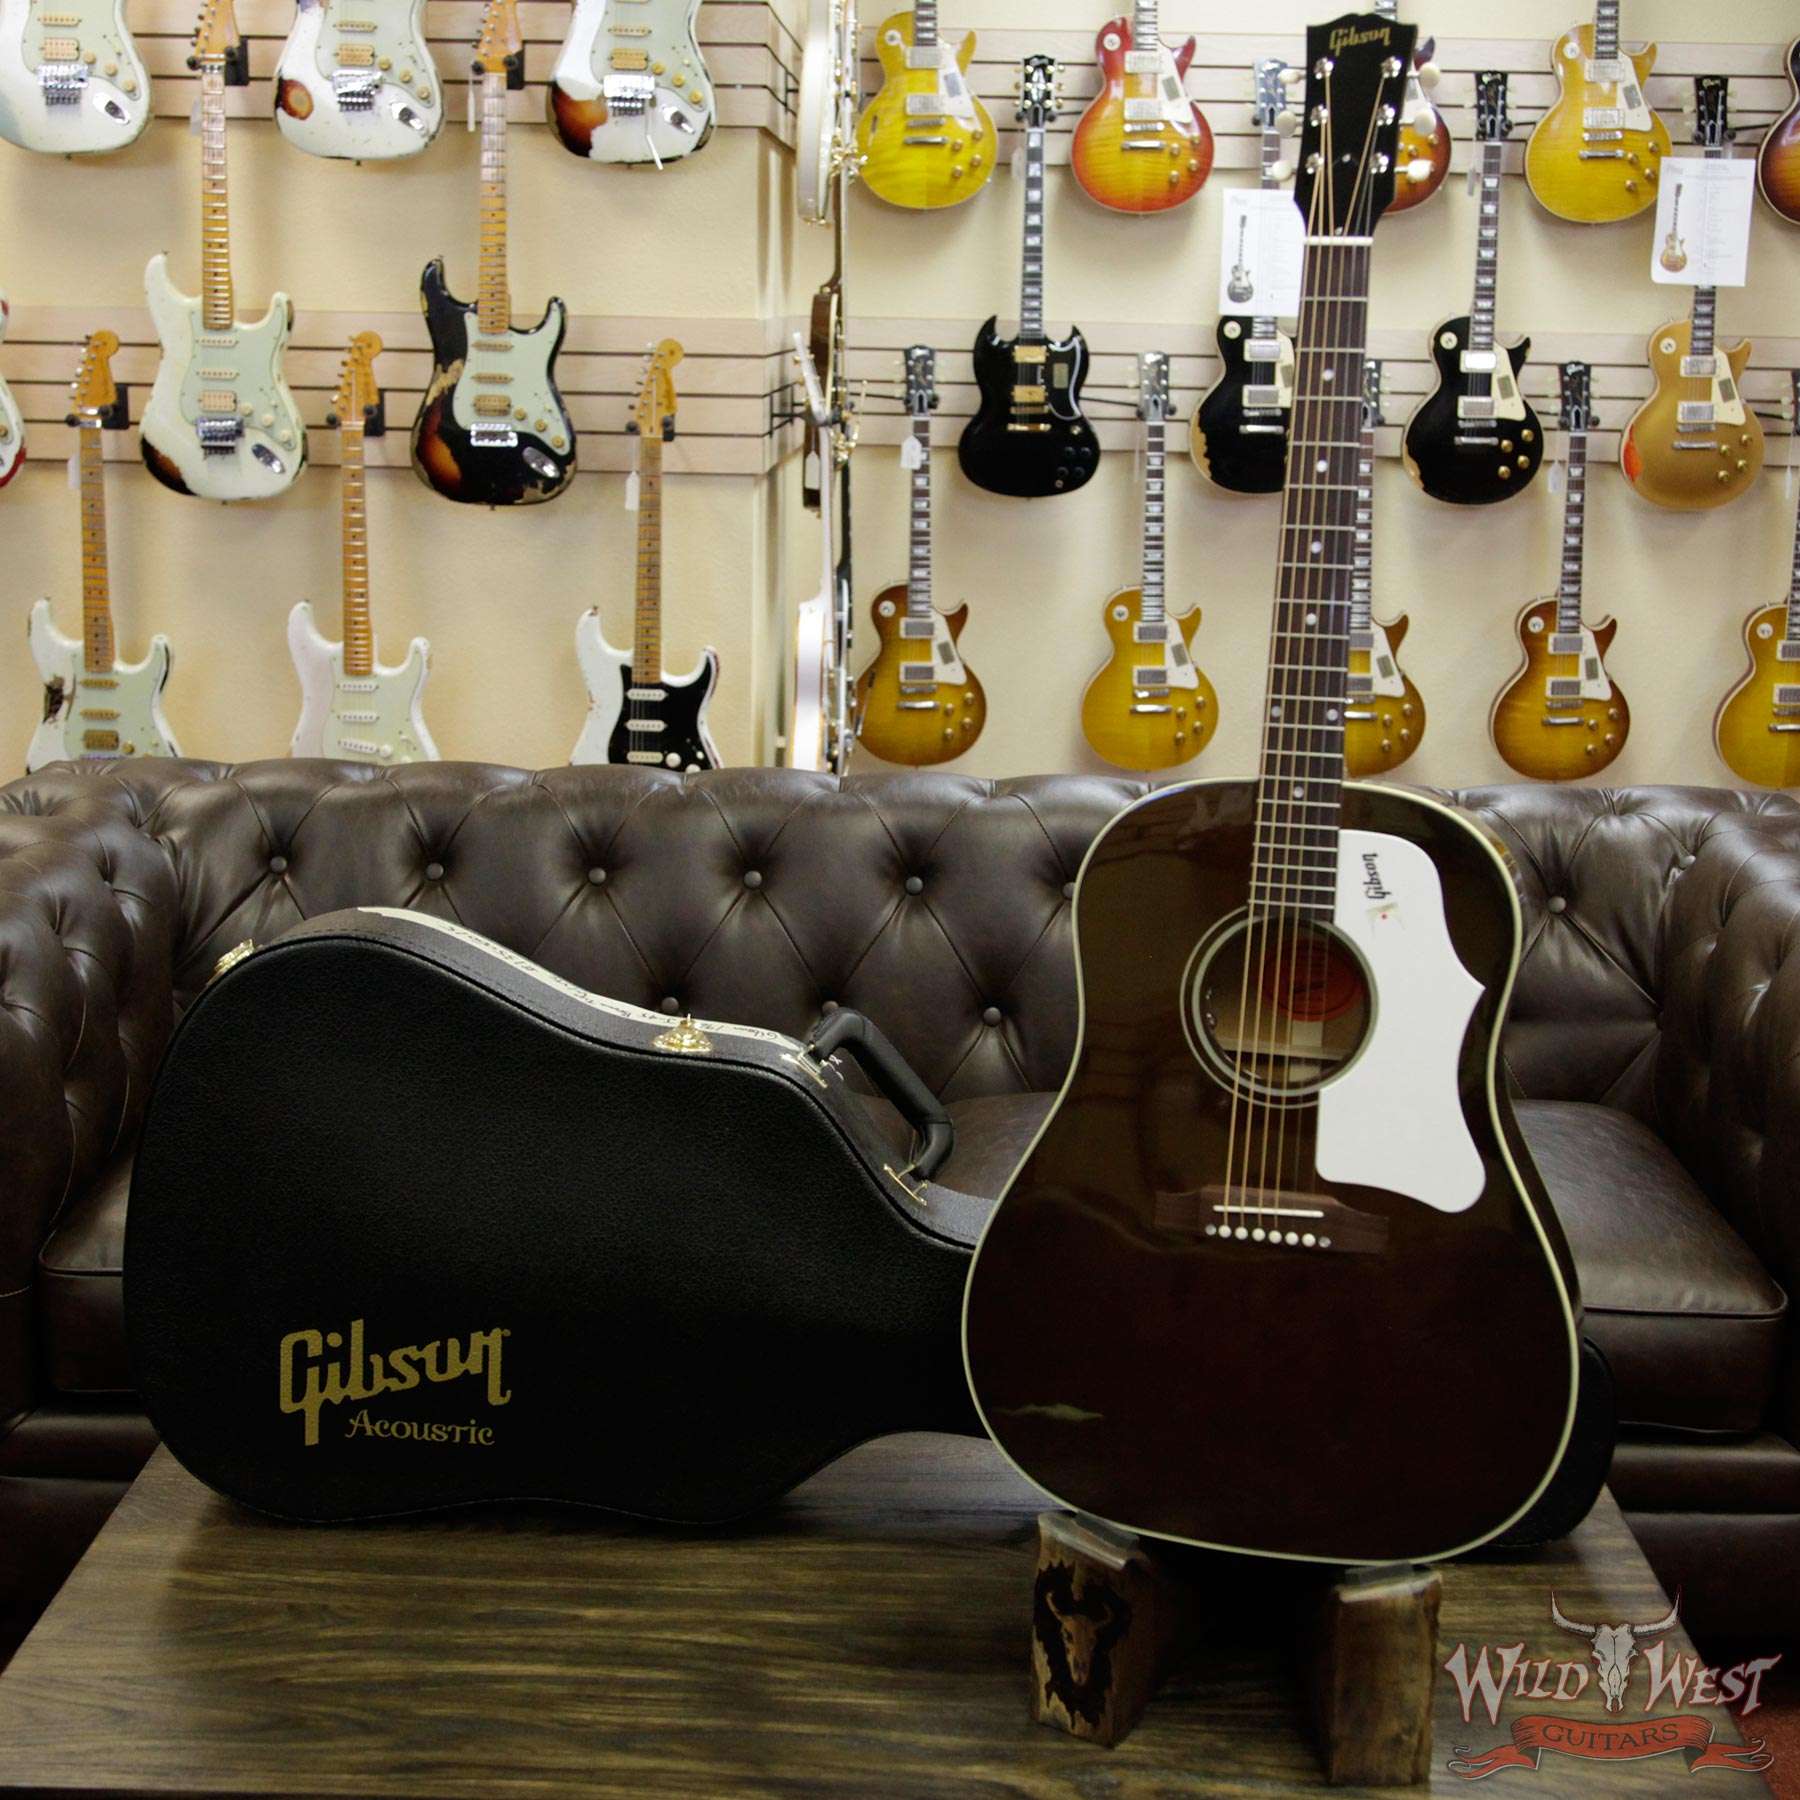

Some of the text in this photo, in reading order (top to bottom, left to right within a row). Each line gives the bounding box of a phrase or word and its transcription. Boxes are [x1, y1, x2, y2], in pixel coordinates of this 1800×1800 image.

[1329, 26, 1391, 57] Gibson
[1362, 853, 1391, 899] Gibson
[279, 1319, 511, 1446] Gibson
